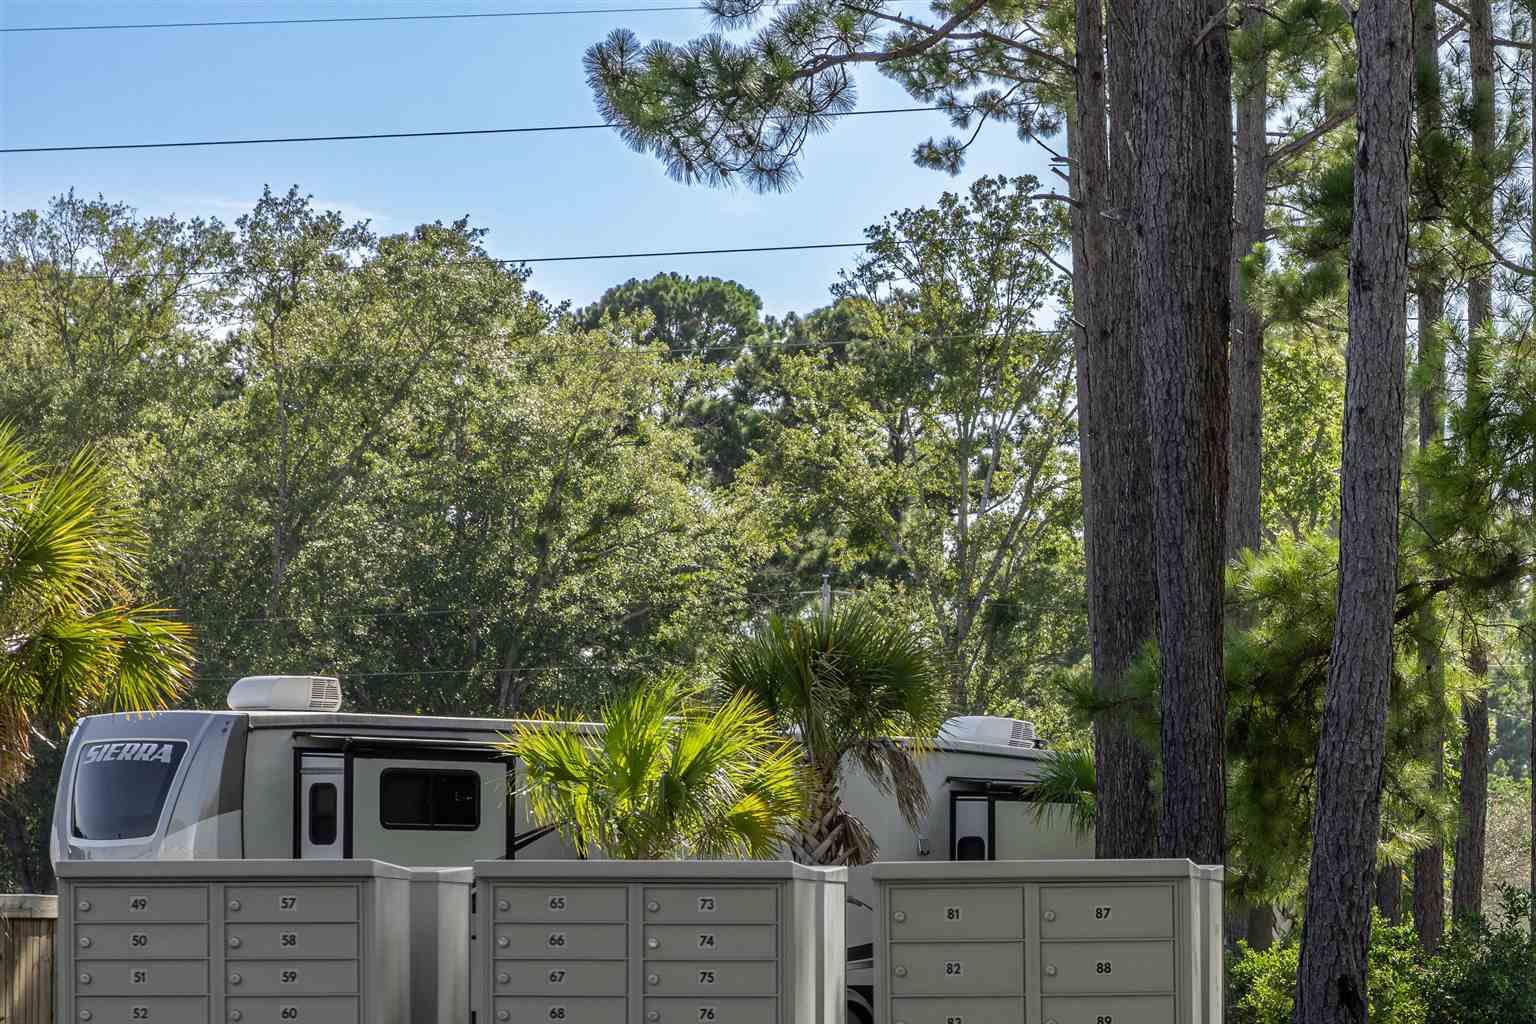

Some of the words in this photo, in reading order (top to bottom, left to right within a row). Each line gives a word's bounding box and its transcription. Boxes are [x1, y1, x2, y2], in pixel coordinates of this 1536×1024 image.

[84, 743, 173, 764] SIERRA
[131, 898, 147, 910] 49
[281, 897, 297, 909] 57
[550, 897, 565, 909] 65
[700, 898, 714, 910] 73
[947, 908, 960, 920] 81
[1095, 907, 1111, 919] 87
[132, 935, 147, 947] 50
[282, 934, 297, 946] 58
[549, 935, 565, 946] 66
[699, 935, 714, 946] 74
[946, 962, 961, 975] 82
[1096, 962, 1112, 974] 88
[134, 971, 145, 983] 51
[282, 971, 297, 983] 59
[549, 971, 565, 982] 67
[700, 971, 714, 983] 75
[133, 1007, 148, 1019] 52
[281, 1007, 298, 1019] 60
[550, 1007, 565, 1019] 68
[700, 1008, 715, 1020] 76
